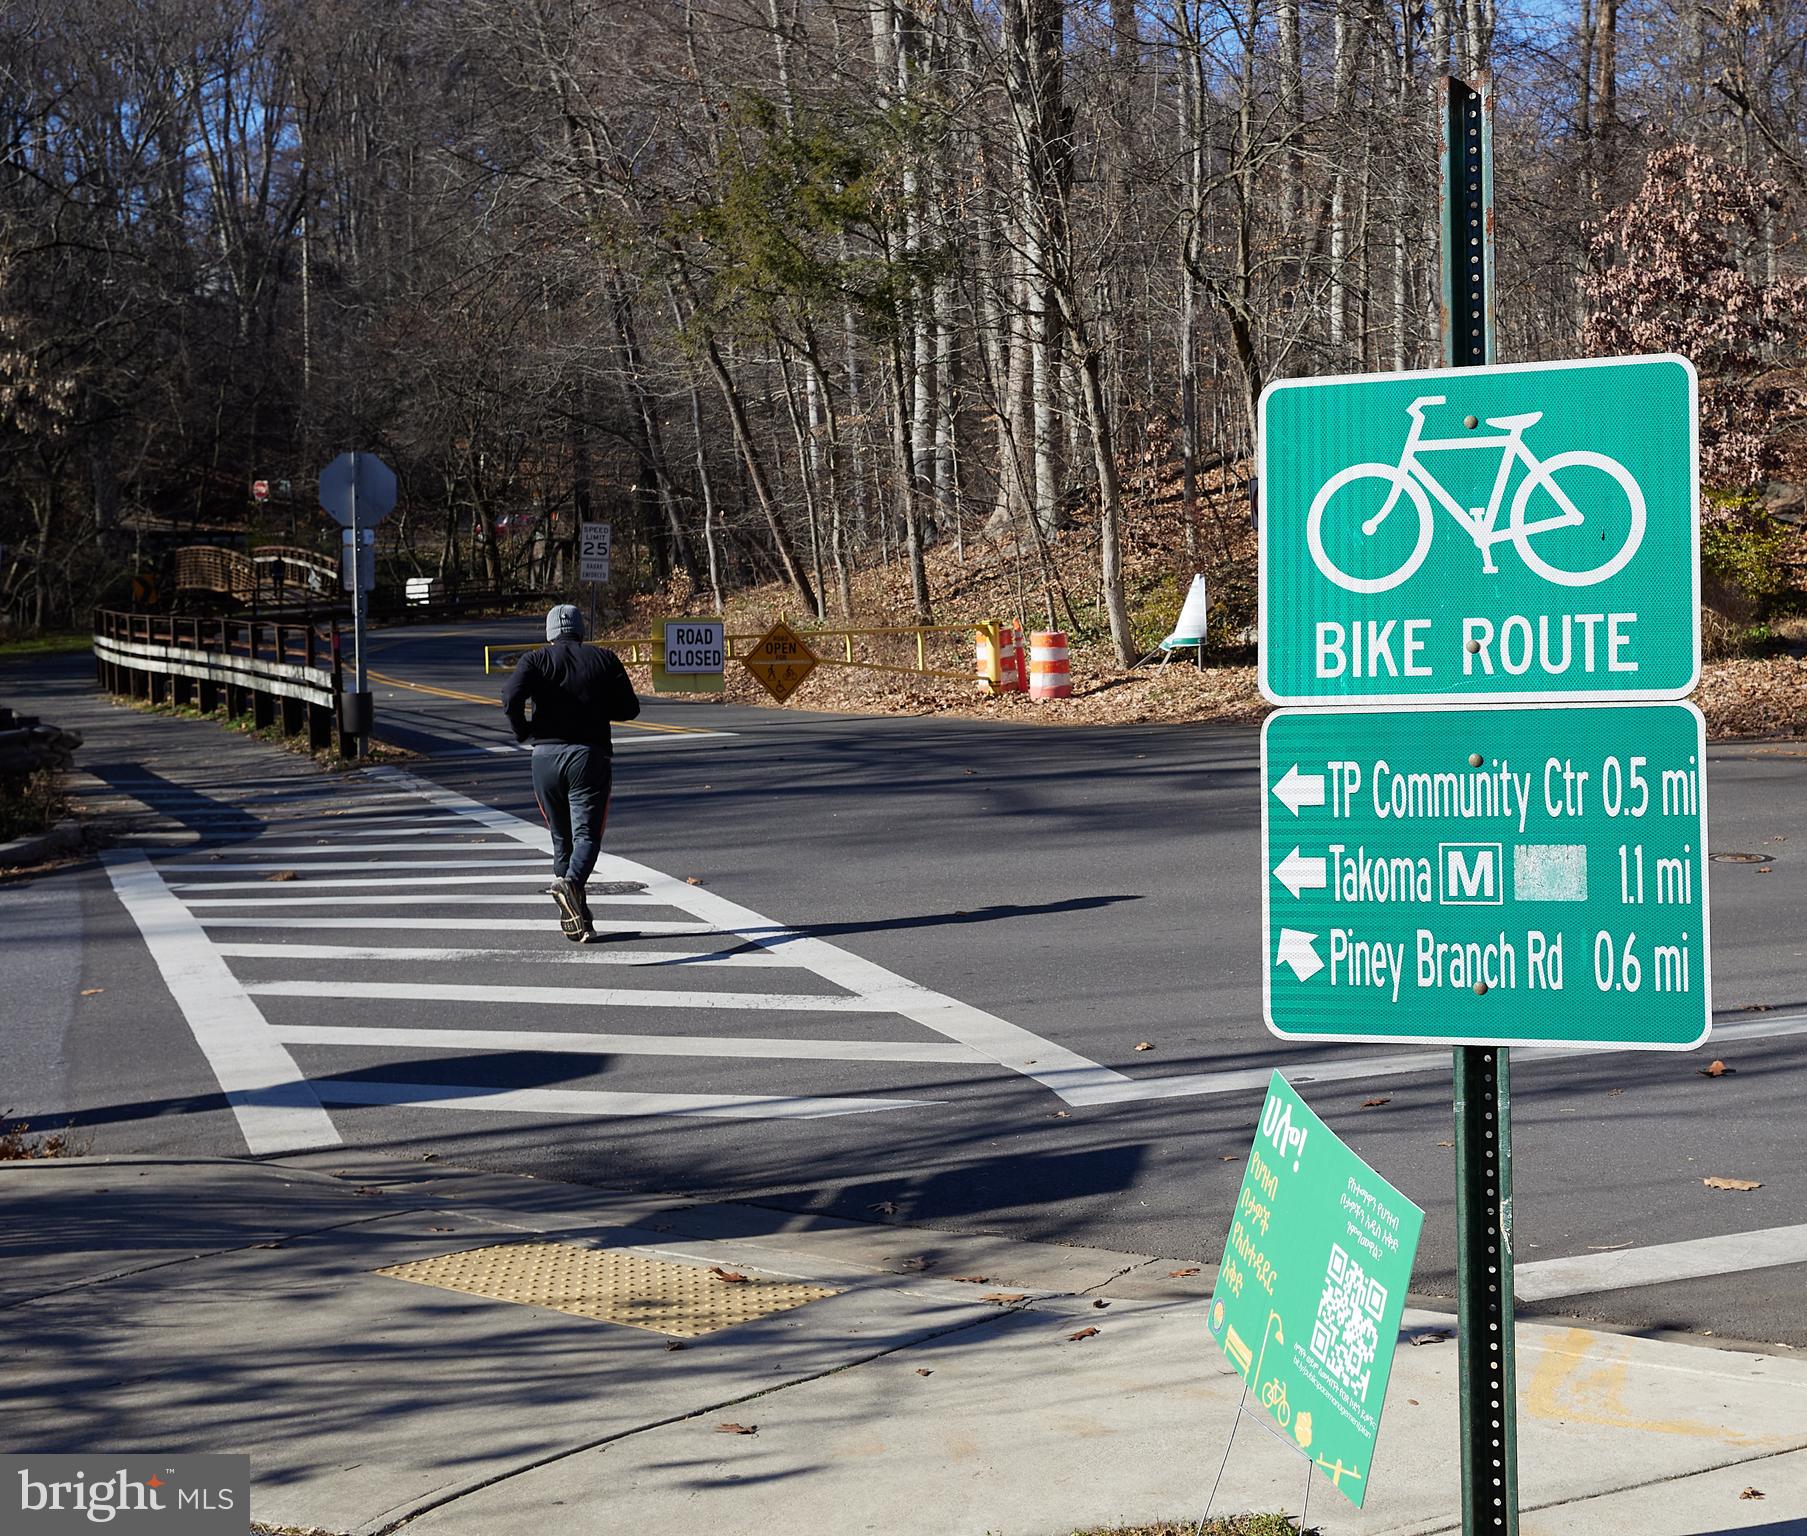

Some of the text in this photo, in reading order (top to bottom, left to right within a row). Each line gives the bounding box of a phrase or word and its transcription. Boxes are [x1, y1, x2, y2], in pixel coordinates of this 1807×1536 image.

[583, 526, 609, 534] SPEED
[583, 541, 608, 556] 25
[676, 628, 713, 646] ROAD
[1315, 612, 1640, 679] BIKE ROUTE
[765, 642, 797, 655] OPEN
[668, 649, 721, 667] CLOSED
[1327, 755, 1698, 834] TP Community Ctr 0.5 mi
[1328, 844, 1692, 905] Takoma M 1.1 mi
[1330, 928, 1689, 1003] Piney Branch Rd 0.6 mi
